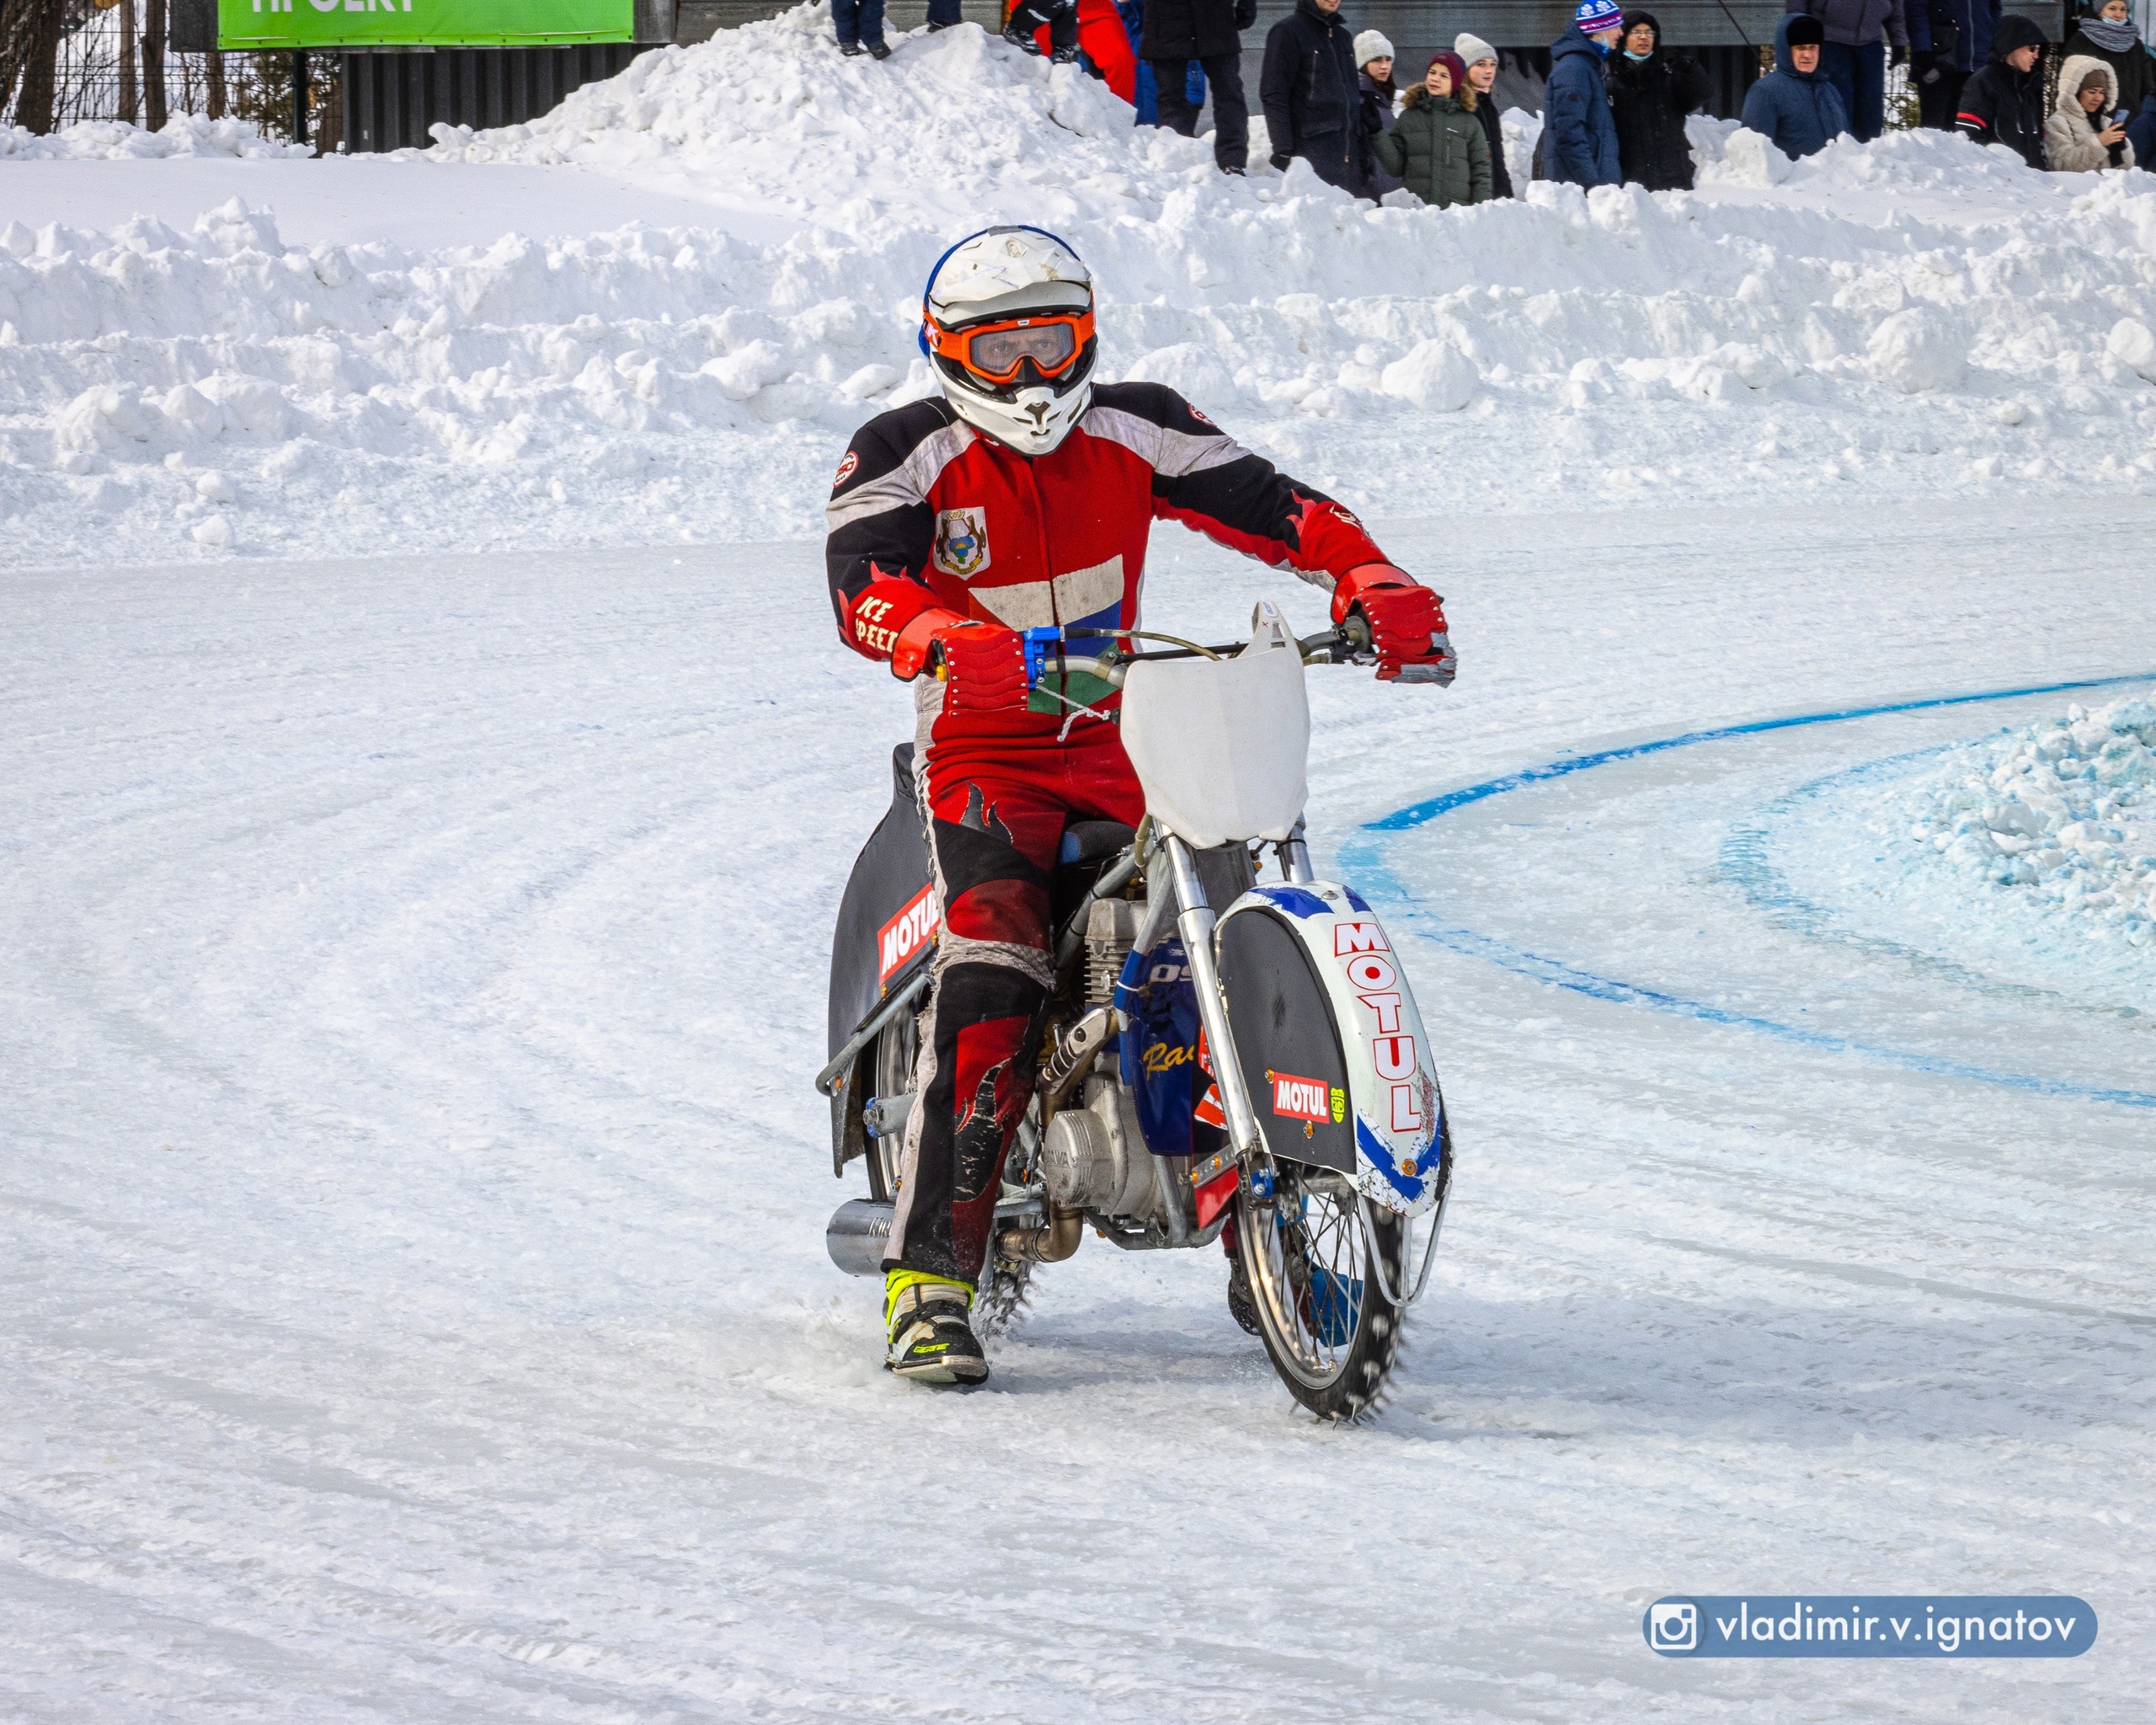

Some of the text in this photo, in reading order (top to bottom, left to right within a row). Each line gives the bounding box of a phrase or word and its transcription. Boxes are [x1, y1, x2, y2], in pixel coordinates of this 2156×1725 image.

[856, 596, 894, 622] ICE
[882, 890, 939, 976] MOTUL
[1335, 922, 1422, 1132] MOTUL
[1277, 1080, 1327, 1116] MOTUL
